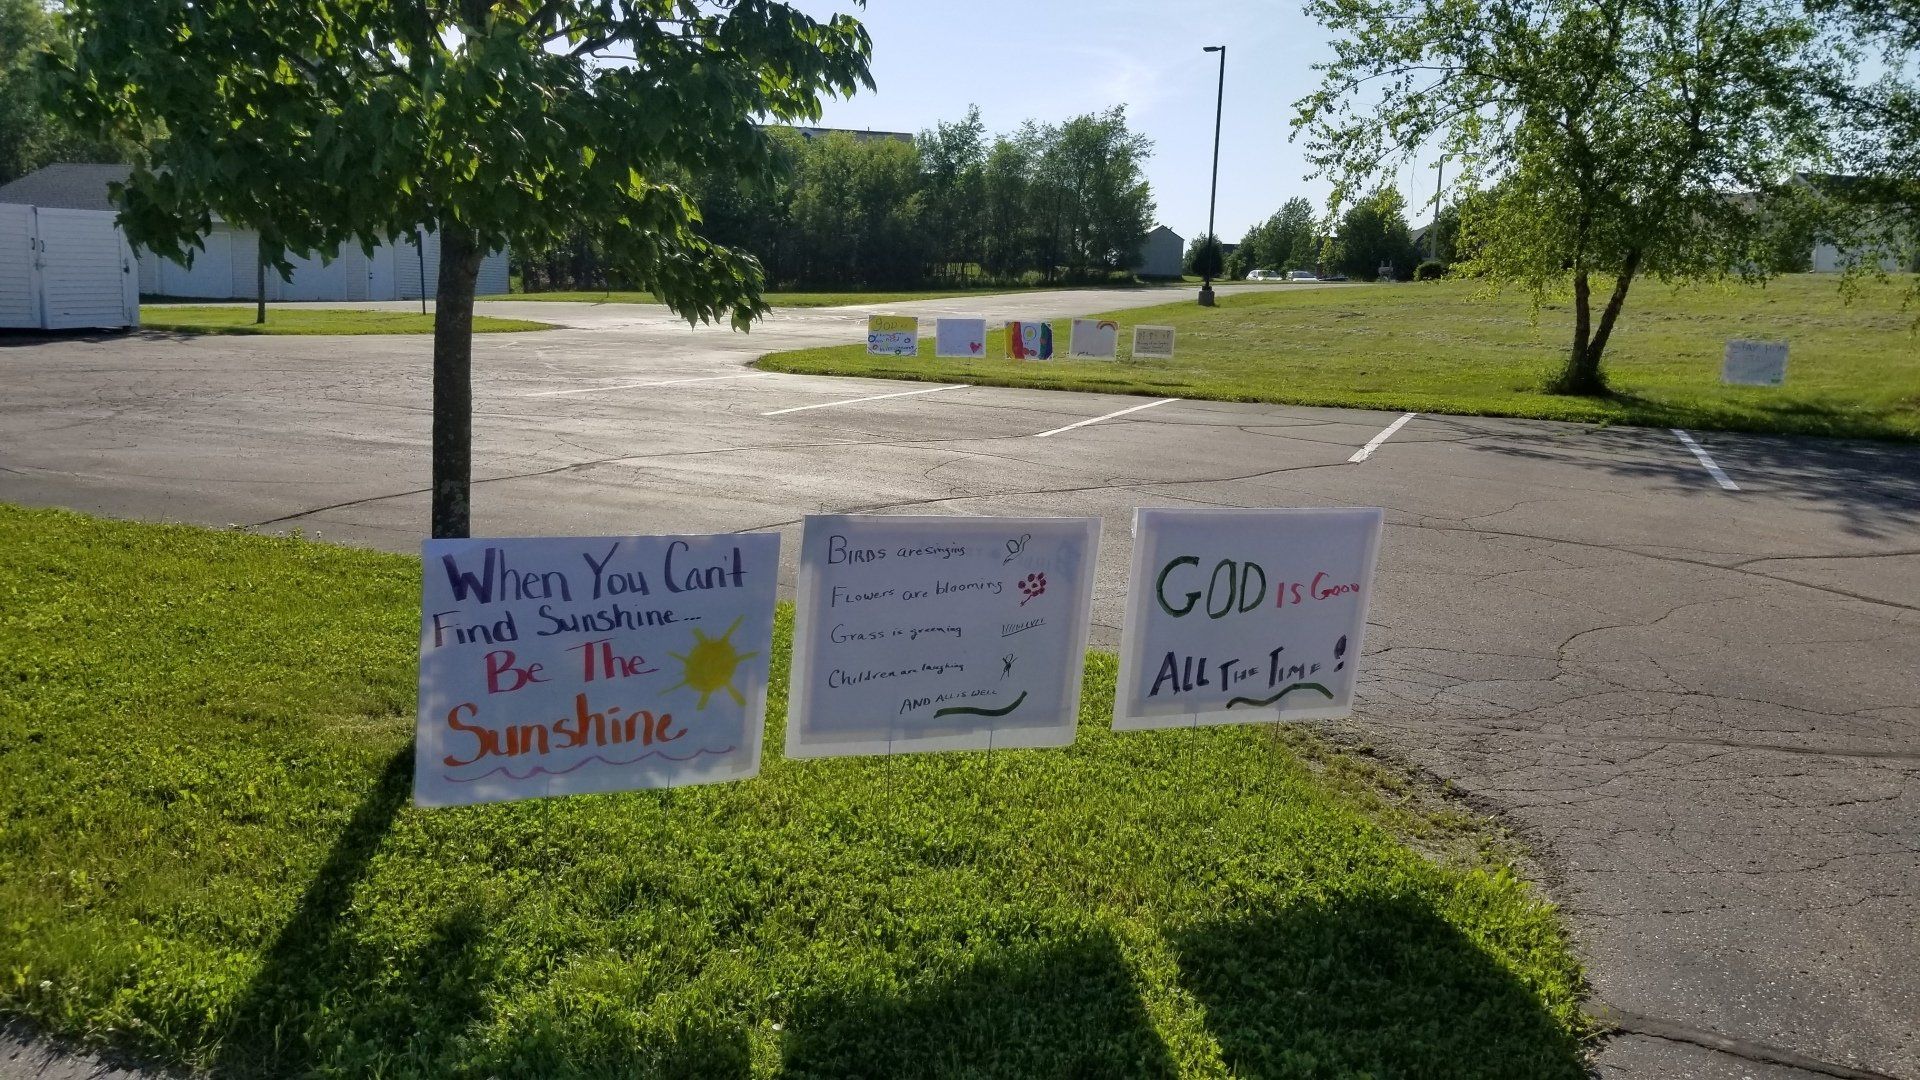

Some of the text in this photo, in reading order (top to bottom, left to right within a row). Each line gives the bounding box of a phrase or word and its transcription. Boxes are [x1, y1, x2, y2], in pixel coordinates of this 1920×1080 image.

[827, 534, 887, 566] BIRDS
[442, 540, 748, 604] When You Can't
[1156, 555, 1267, 620] GOD
[1275, 582, 1304, 609] IS
[902, 590, 929, 601] are
[935, 578, 1003, 595] blooming
[432, 610, 518, 648] Find
[830, 624, 962, 643] Grass is greening
[484, 638, 659, 695] Be The
[827, 663, 965, 689] Children are laughing
[1217, 658, 1260, 692] THE
[899, 697, 931, 715] AND
[970, 689, 999, 697] WELL
[443, 693, 689, 767] Sunshine
